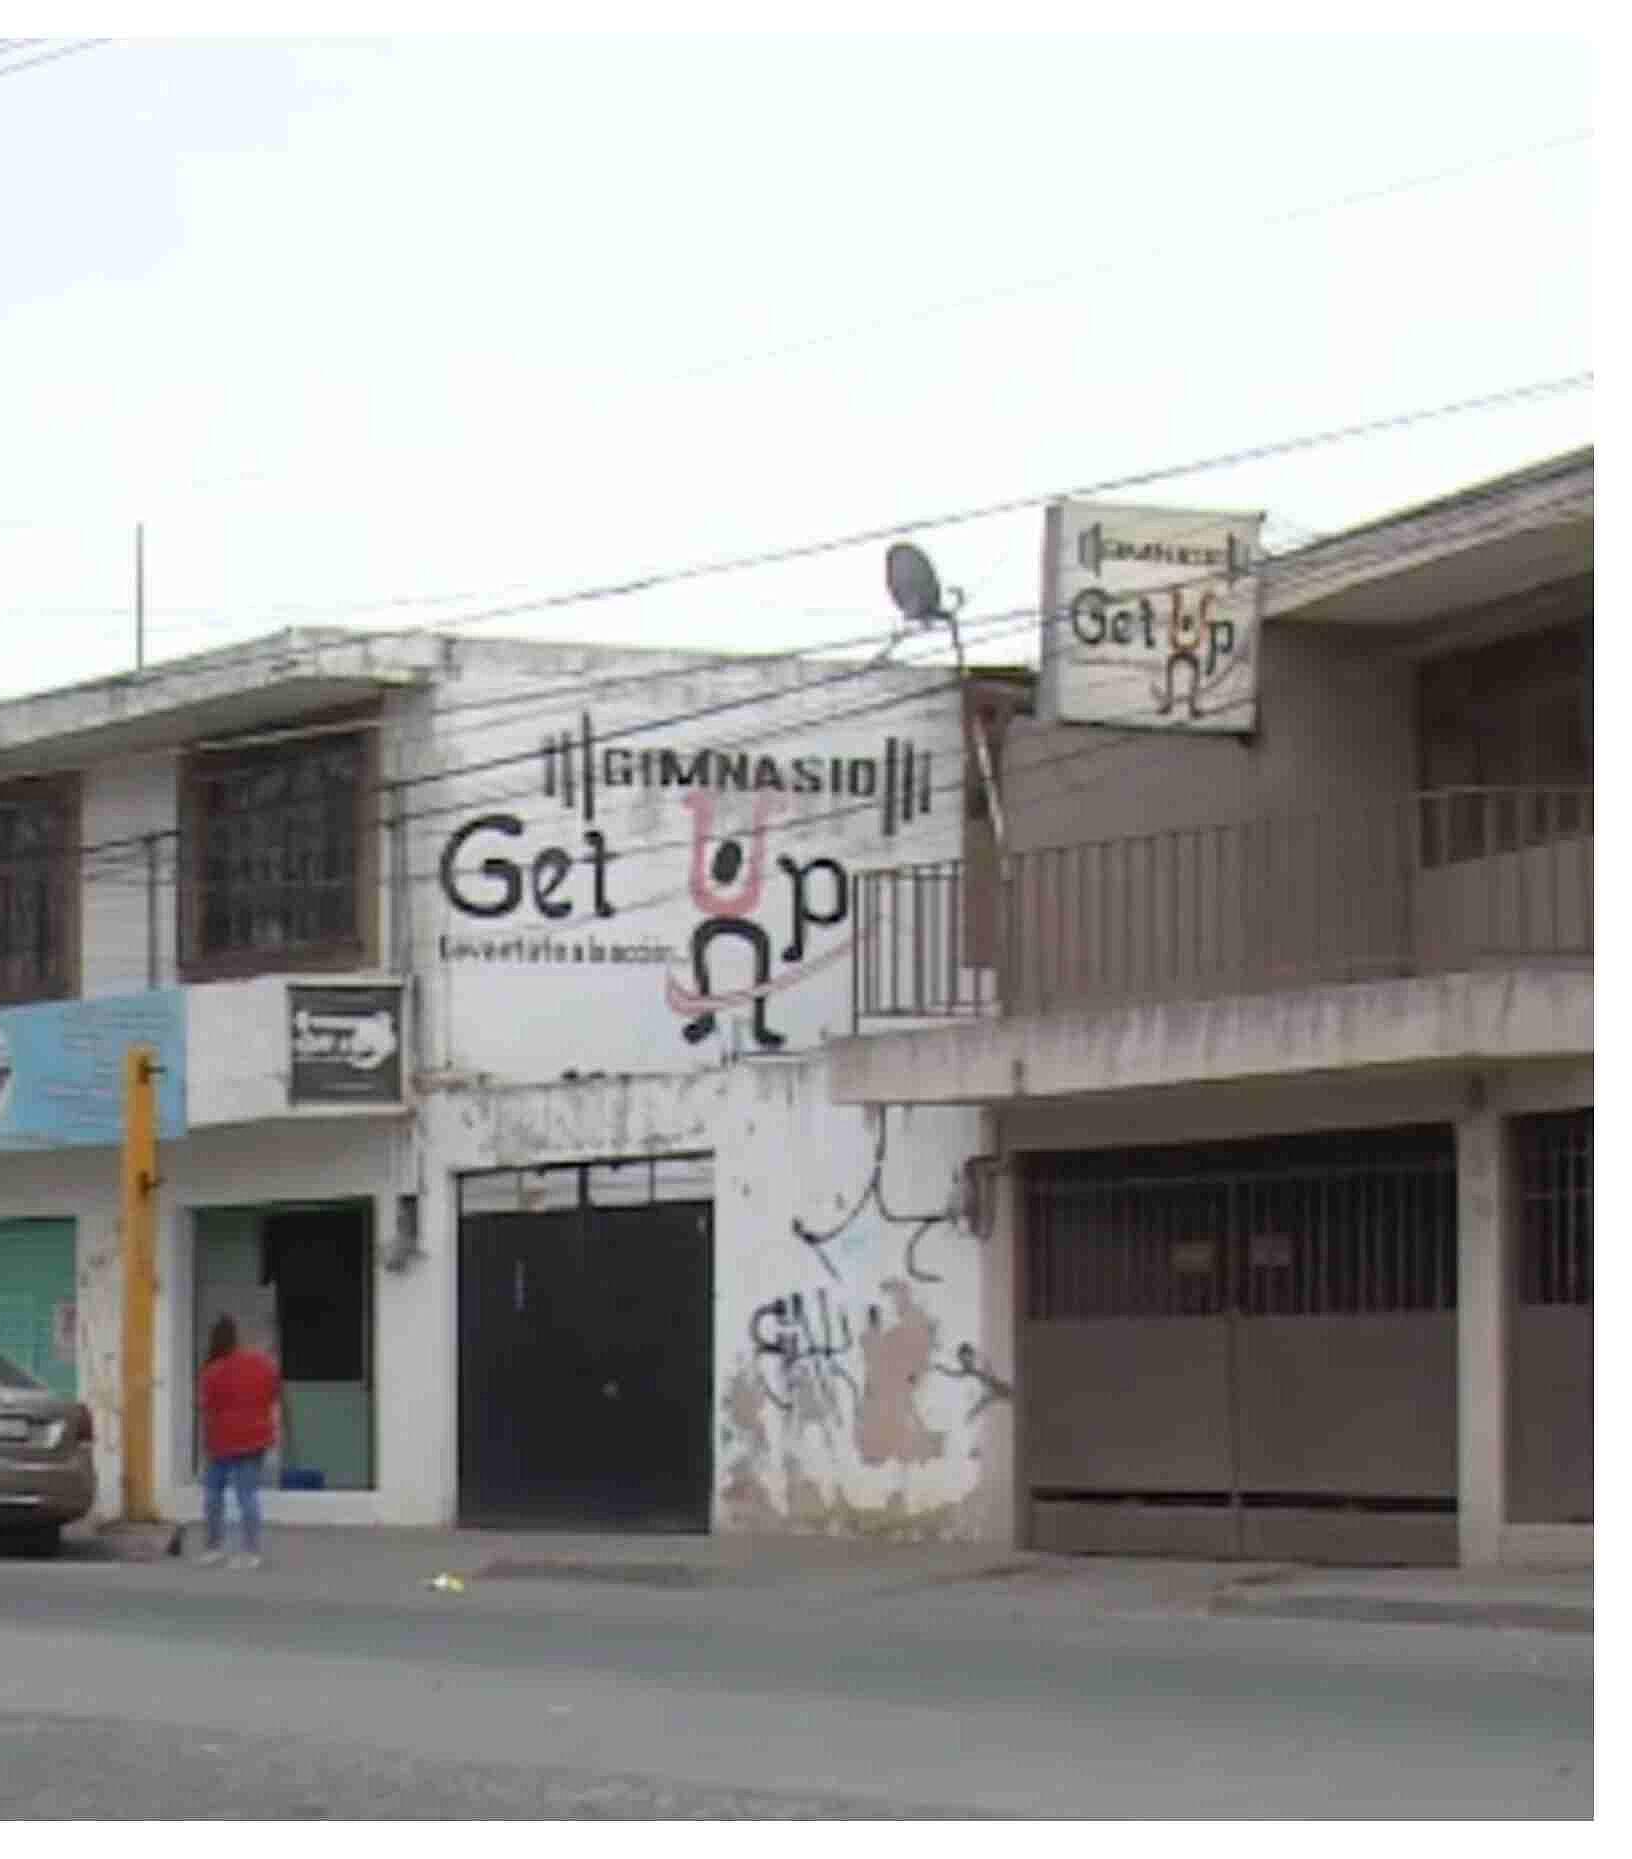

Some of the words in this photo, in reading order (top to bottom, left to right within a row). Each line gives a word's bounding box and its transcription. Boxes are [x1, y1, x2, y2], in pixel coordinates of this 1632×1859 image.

[1073, 588, 1155, 649] Get
[603, 747, 878, 797] GIMNASIO
[440, 813, 616, 919] Get
[684, 792, 850, 963] Up
